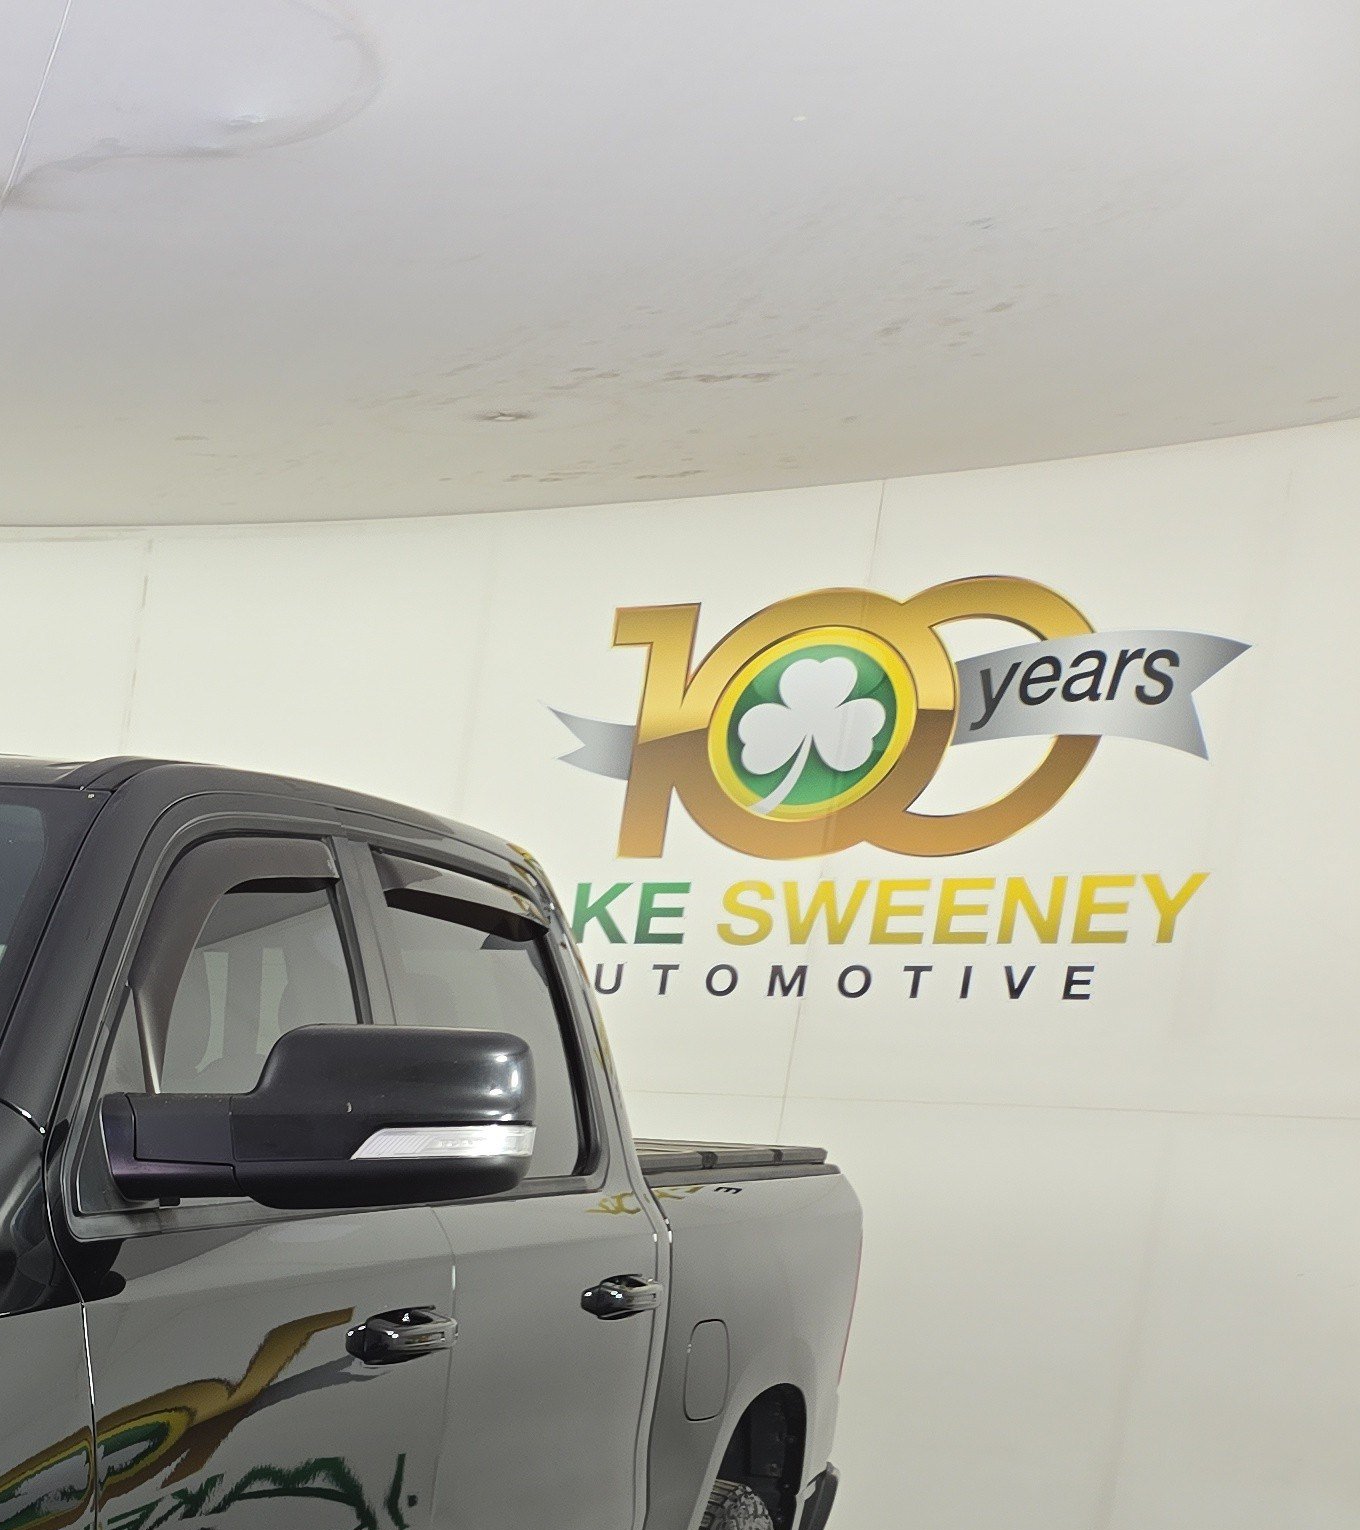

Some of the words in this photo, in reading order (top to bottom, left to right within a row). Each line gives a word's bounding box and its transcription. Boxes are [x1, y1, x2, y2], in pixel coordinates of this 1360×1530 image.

[612, 574, 1104, 861] 100
[968, 646, 1180, 733] years
[570, 881, 692, 945] KE
[716, 871, 1211, 947] SWEENEY
[593, 962, 1097, 1002] UTOMOTIVE
